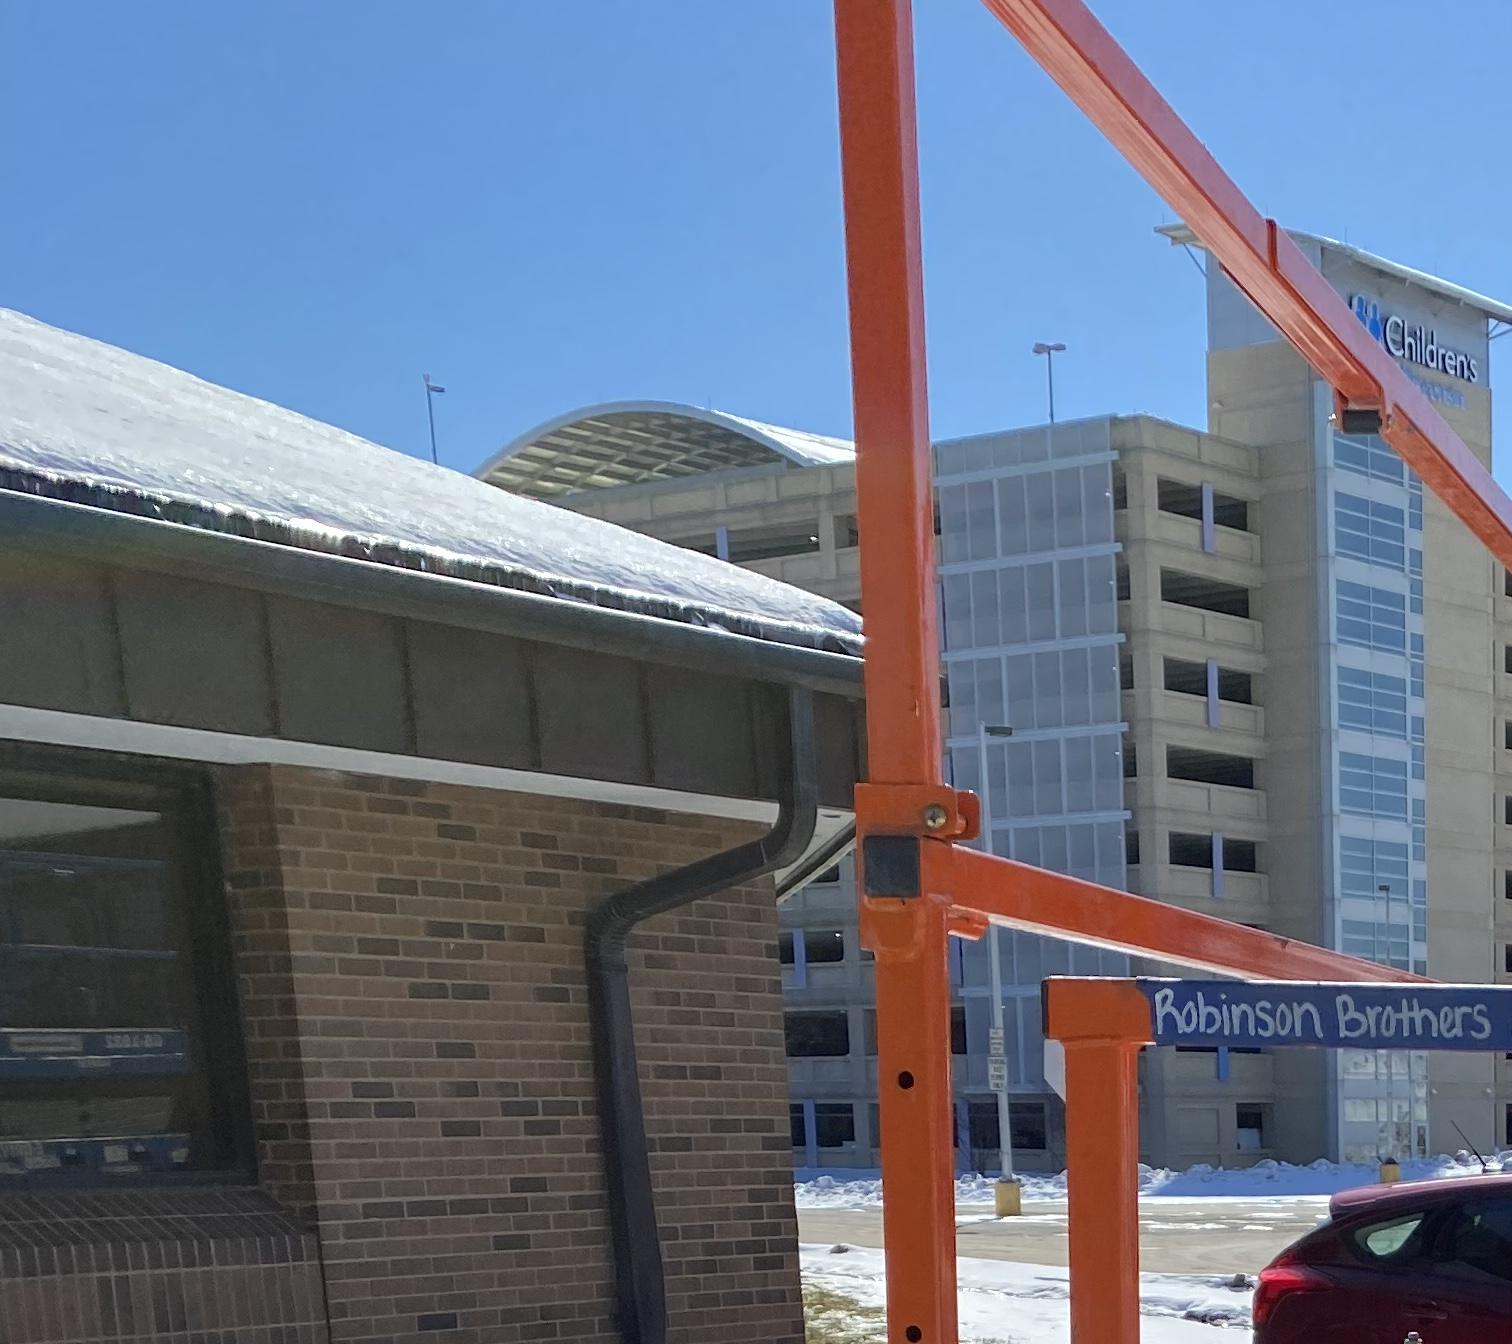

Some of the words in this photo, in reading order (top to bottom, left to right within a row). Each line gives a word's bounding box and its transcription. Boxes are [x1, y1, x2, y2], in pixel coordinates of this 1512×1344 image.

[1383, 315, 1478, 383] Children's
[1154, 986, 1323, 1040] Robinson
[1337, 995, 1493, 1042] Brothers
